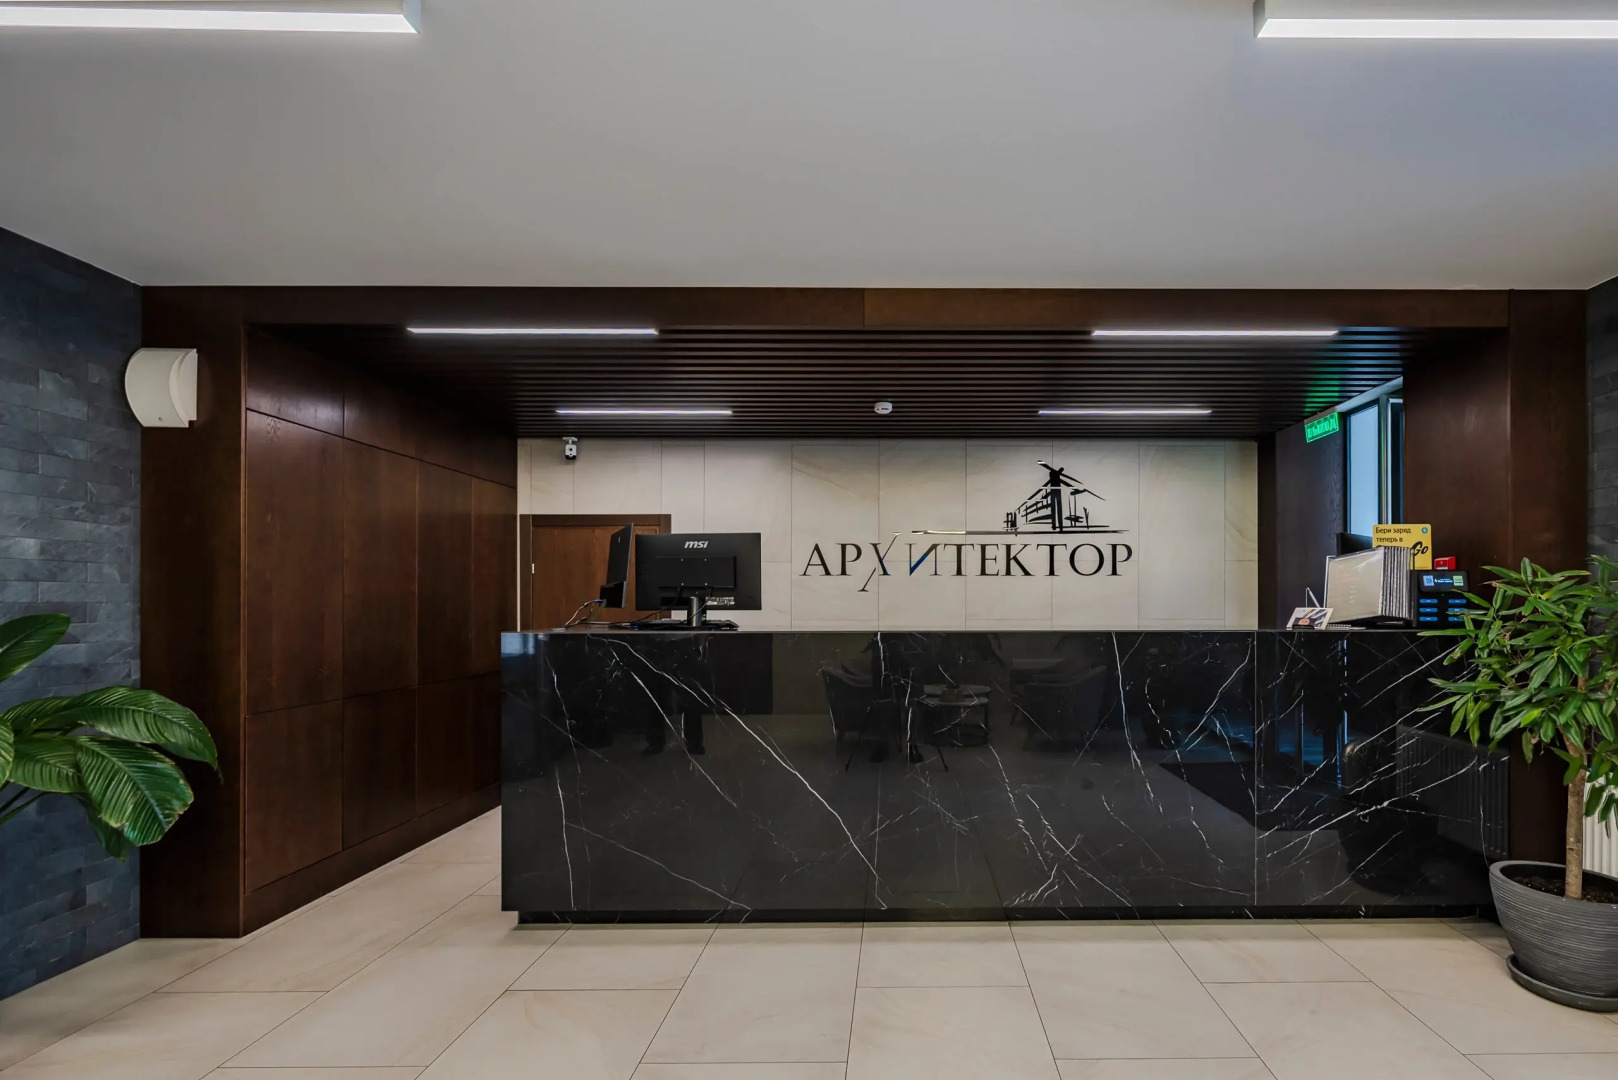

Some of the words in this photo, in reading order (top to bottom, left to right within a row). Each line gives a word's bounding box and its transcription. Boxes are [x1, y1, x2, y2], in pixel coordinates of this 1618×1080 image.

[1307, 418, 1337, 438] ВЫХОД
[1375, 526, 1391, 534] Бери
[684, 540, 709, 549] msi
[1411, 541, 1429, 556] Go
[799, 532, 1133, 592] АРХИТЕКТОР
